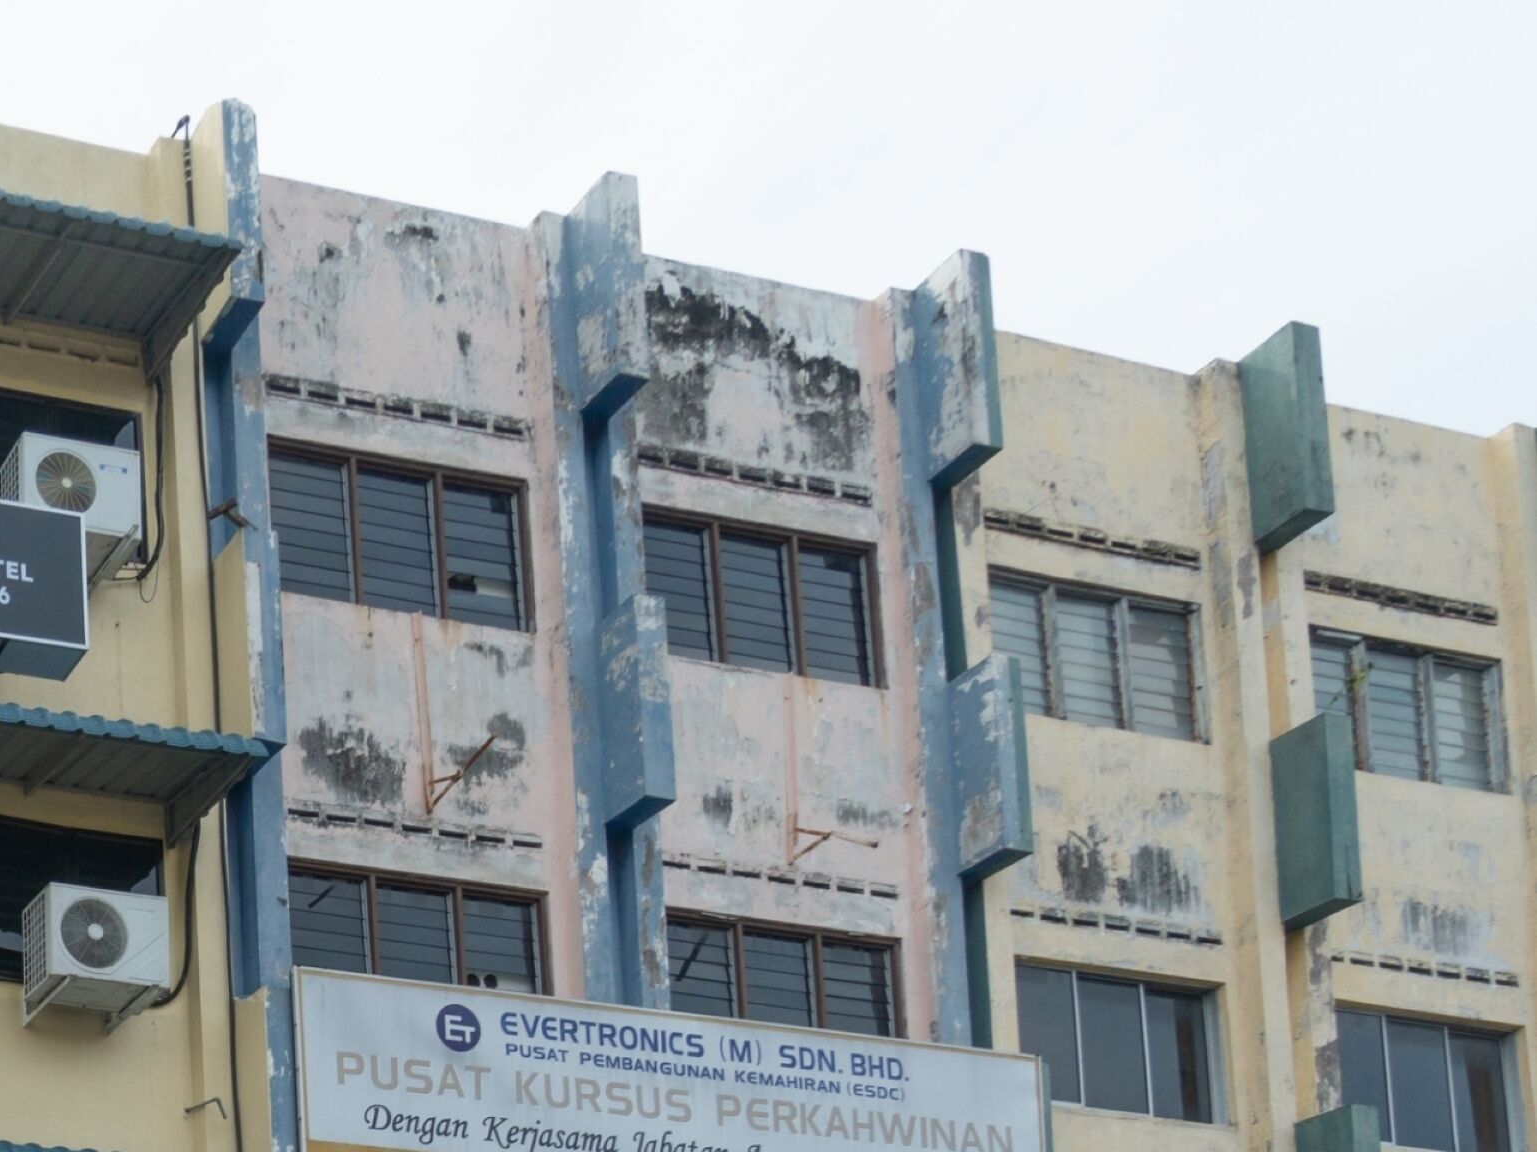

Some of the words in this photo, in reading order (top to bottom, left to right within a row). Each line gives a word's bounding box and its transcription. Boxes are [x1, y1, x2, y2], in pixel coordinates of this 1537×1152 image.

[500, 1012, 704, 1058] EVERTRONICS
[719, 1035, 762, 1066] (M)
[779, 1045, 843, 1074] SDN.
[851, 1053, 910, 1081] BHD.
[505, 1043, 569, 1063] PUSAT
[579, 1052, 725, 1081] PEMBANGUNAN
[735, 1070, 841, 1094] KEMAHIRAN
[847, 1082, 905, 1102] (ESDC)
[336, 1051, 491, 1101] PUSAT
[516, 1071, 692, 1123] KURSUS
[364, 1104, 469, 1144] Dengan
